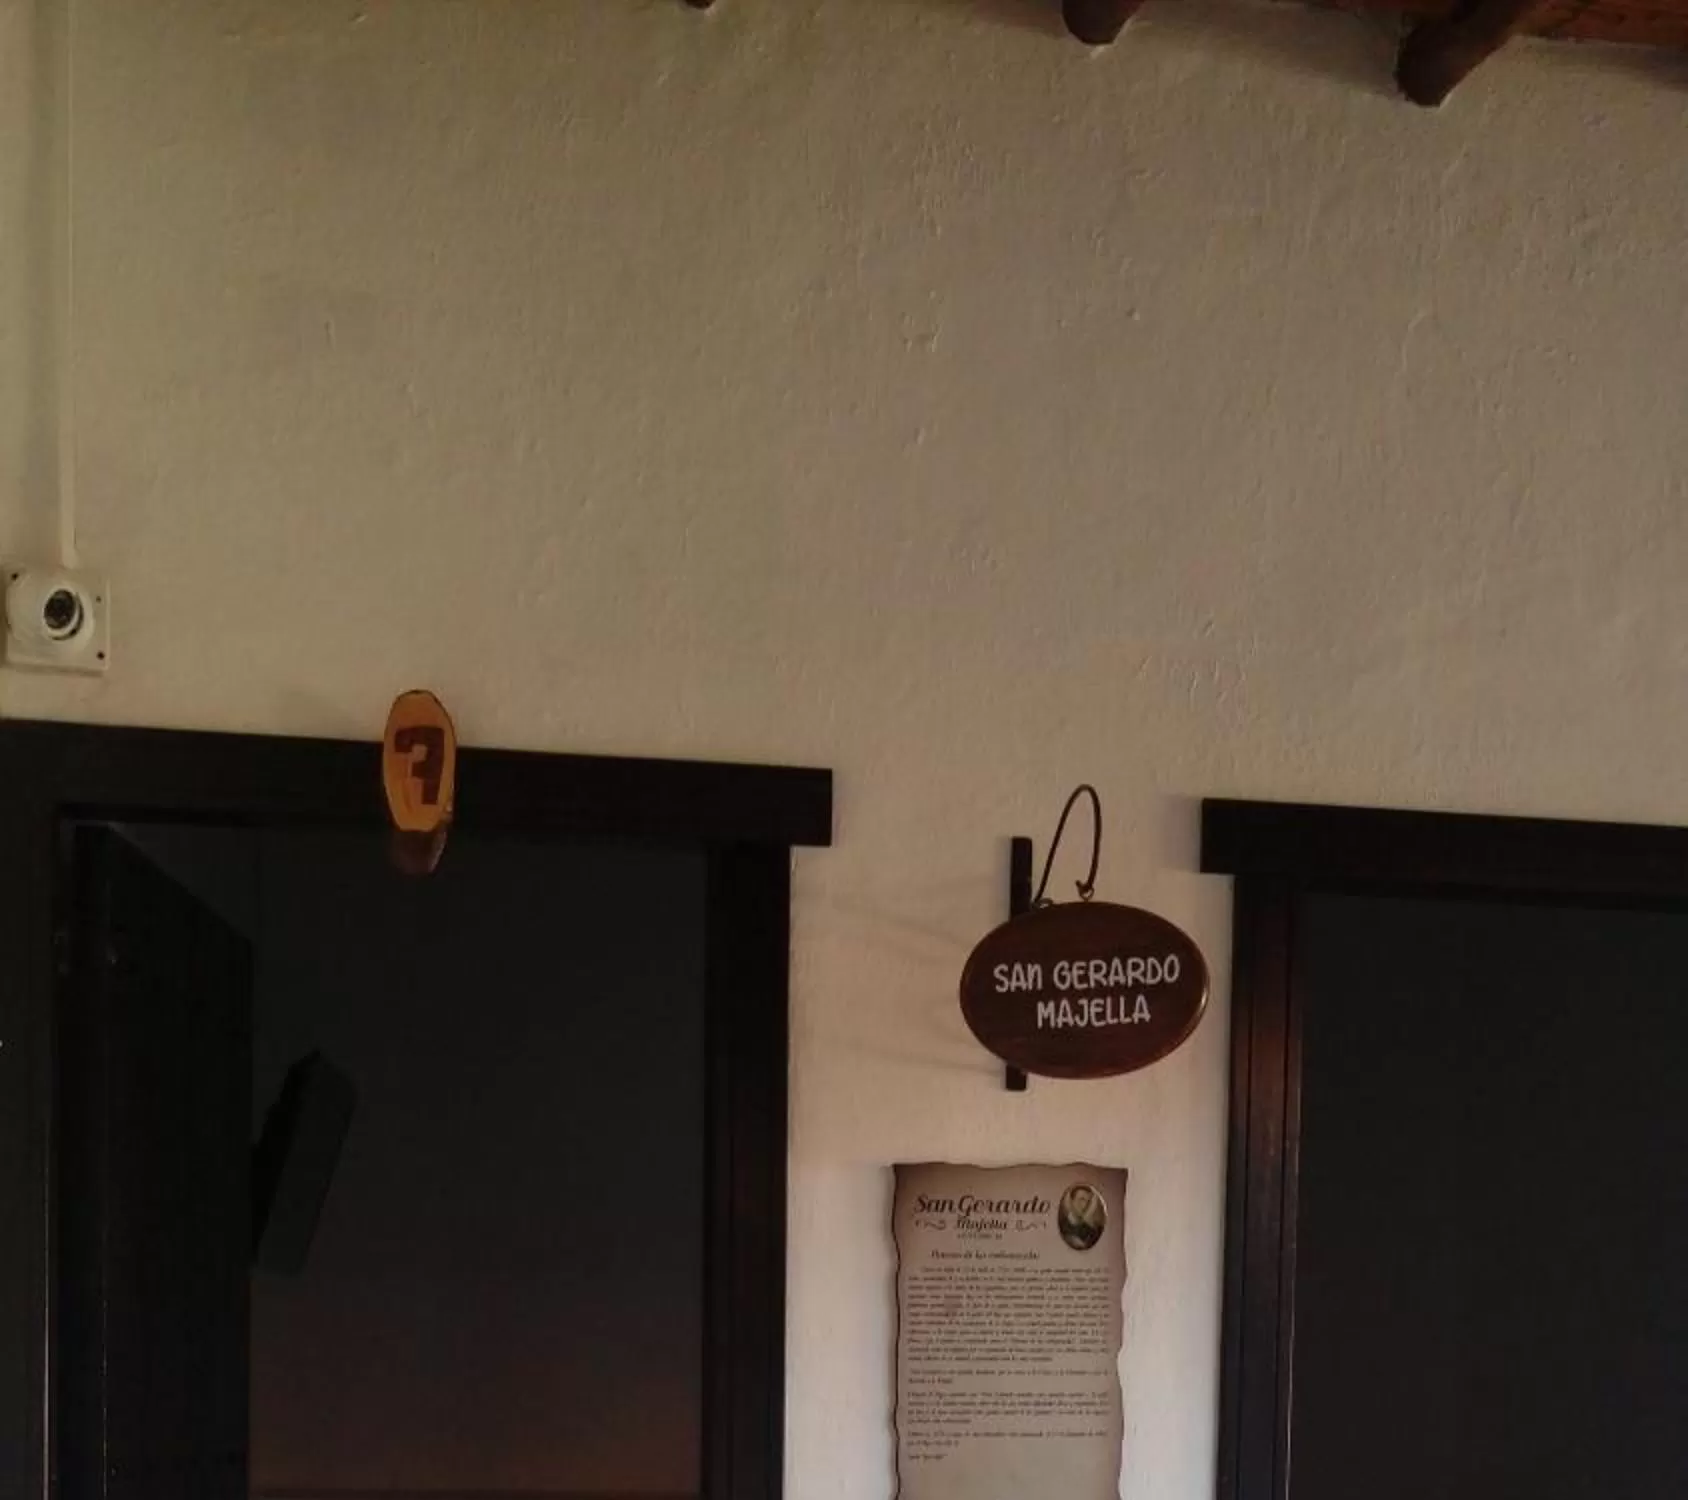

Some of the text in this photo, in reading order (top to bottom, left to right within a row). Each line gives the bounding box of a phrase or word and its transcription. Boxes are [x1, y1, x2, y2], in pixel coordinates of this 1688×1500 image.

[993, 953, 1181, 993] SAN GERARDO
[1036, 994, 1151, 1030] MAJELLA
[913, 1192, 1051, 1217] San Gerardo
